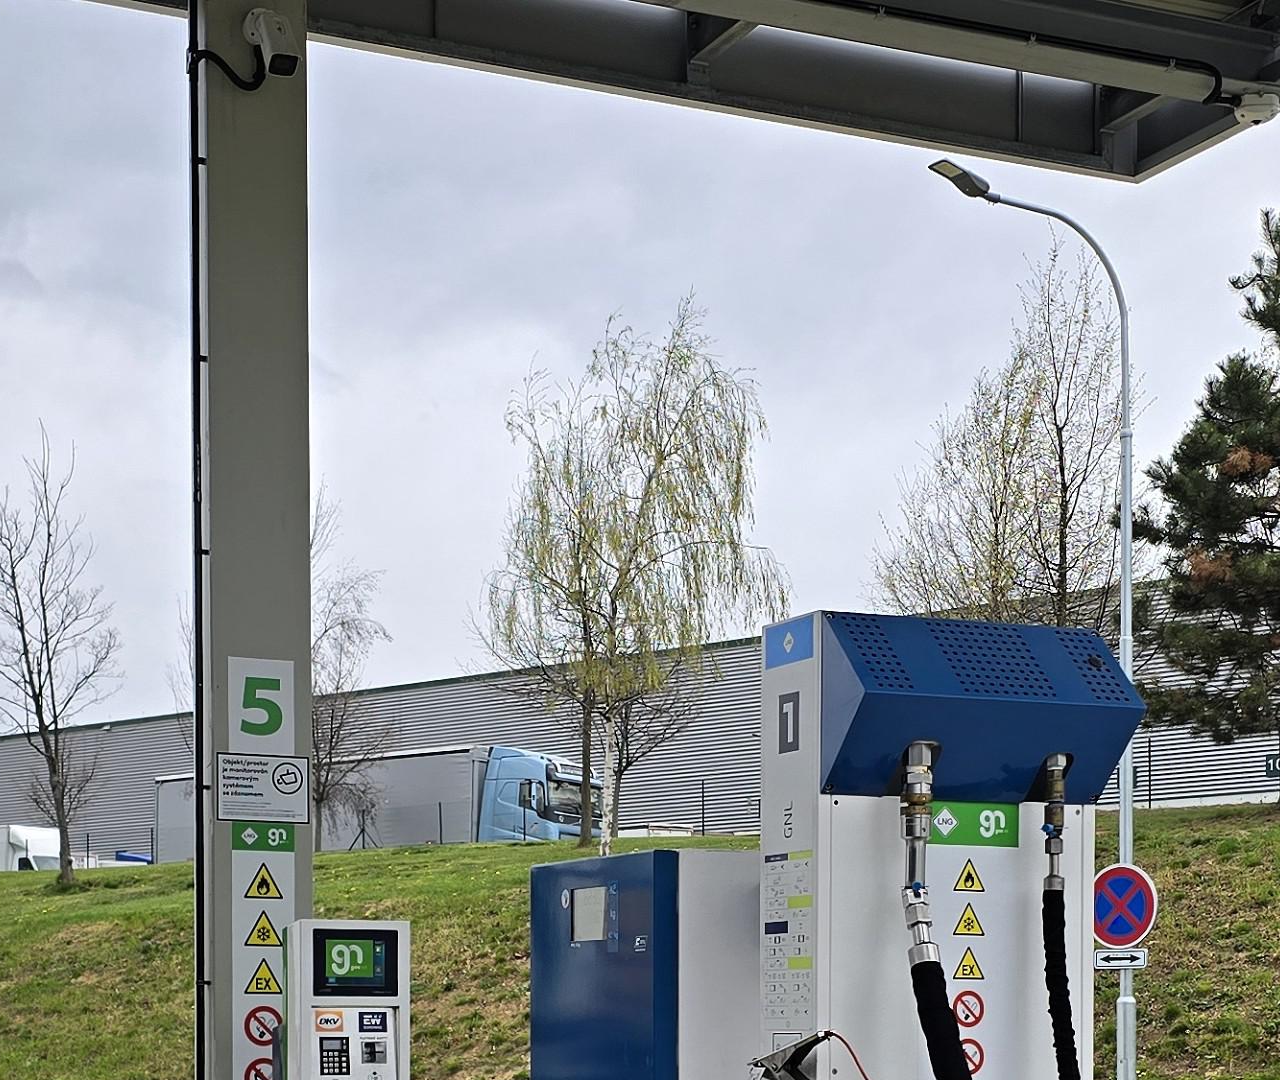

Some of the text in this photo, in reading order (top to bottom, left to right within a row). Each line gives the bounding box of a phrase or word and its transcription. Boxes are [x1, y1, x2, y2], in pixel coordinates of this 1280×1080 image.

[240, 676, 283, 736] 5
[783, 701, 794, 743] 1
[783, 800, 793, 839] GNL
[937, 817, 954, 826] LNG
[962, 965, 975, 976] EX
[255, 978, 272, 990] EX
[319, 1017, 340, 1025] DKV
